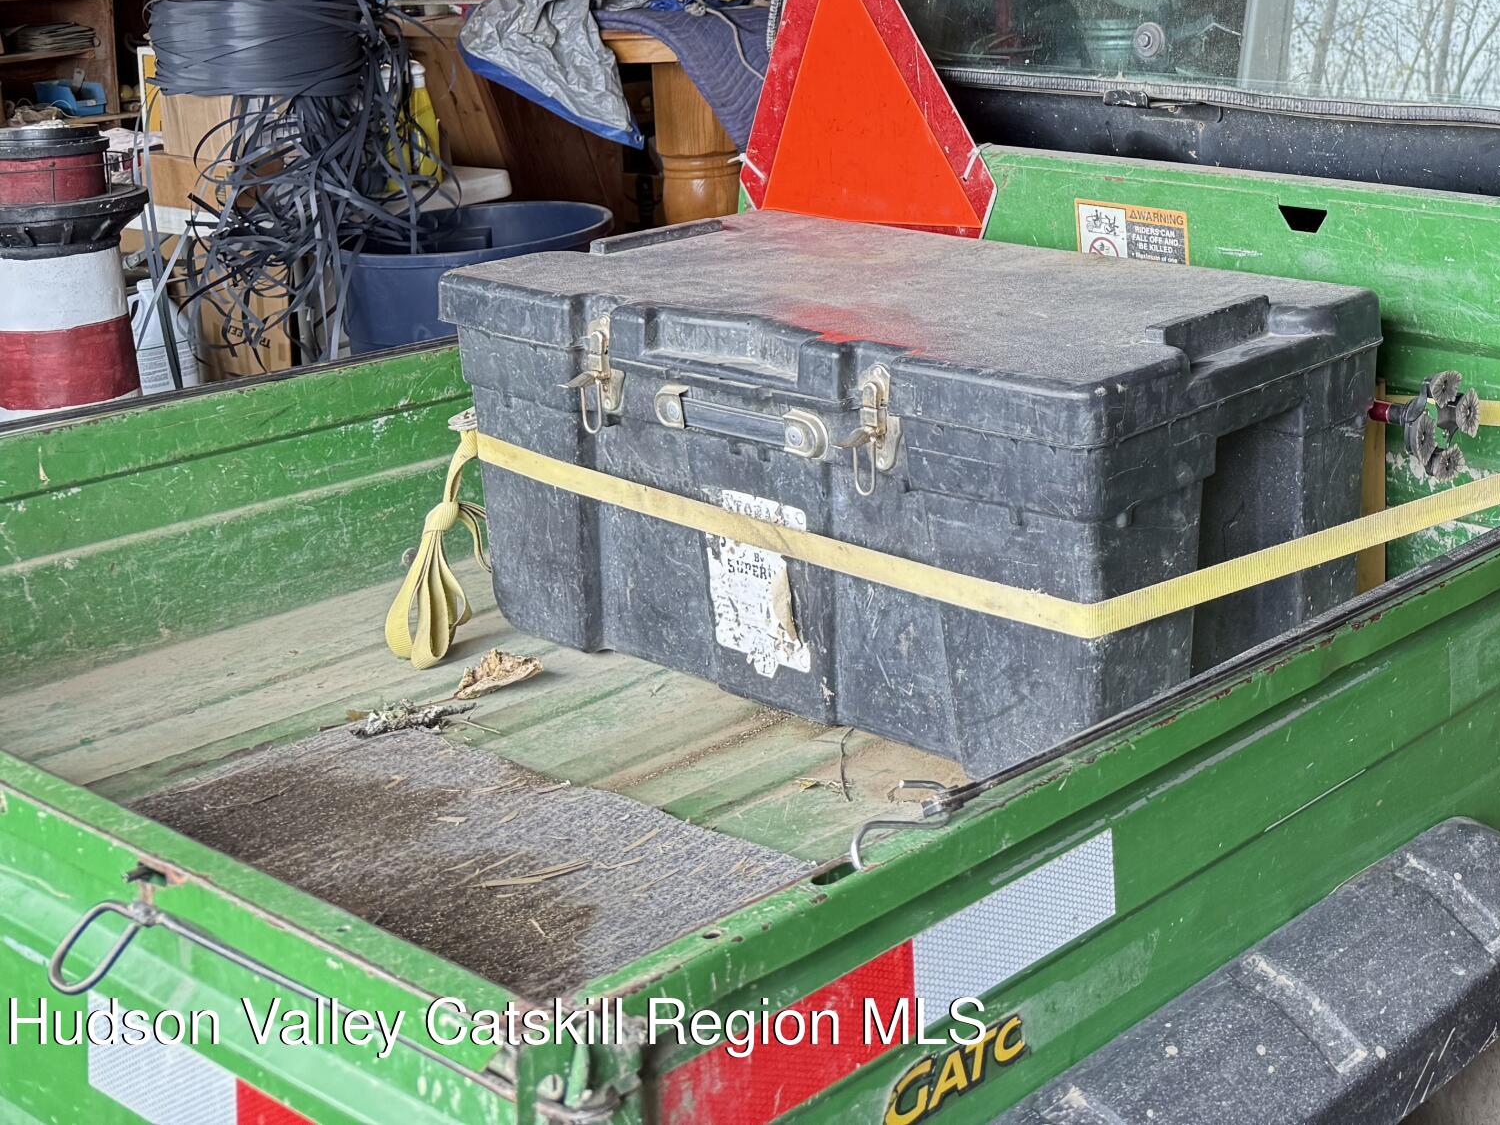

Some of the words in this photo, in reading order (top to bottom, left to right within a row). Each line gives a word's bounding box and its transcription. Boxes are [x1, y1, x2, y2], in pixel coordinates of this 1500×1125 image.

[1137, 211, 1184, 225] WARNING
[1134, 225, 1160, 236] RIDERS
[1160, 229, 1175, 238] CAN
[1132, 233, 1149, 242] FALL
[1149, 236, 1163, 244] OFF
[1164, 238, 1179, 247] AND
[1138, 242, 1148, 250] BE
[1148, 244, 1173, 254] KILLED
